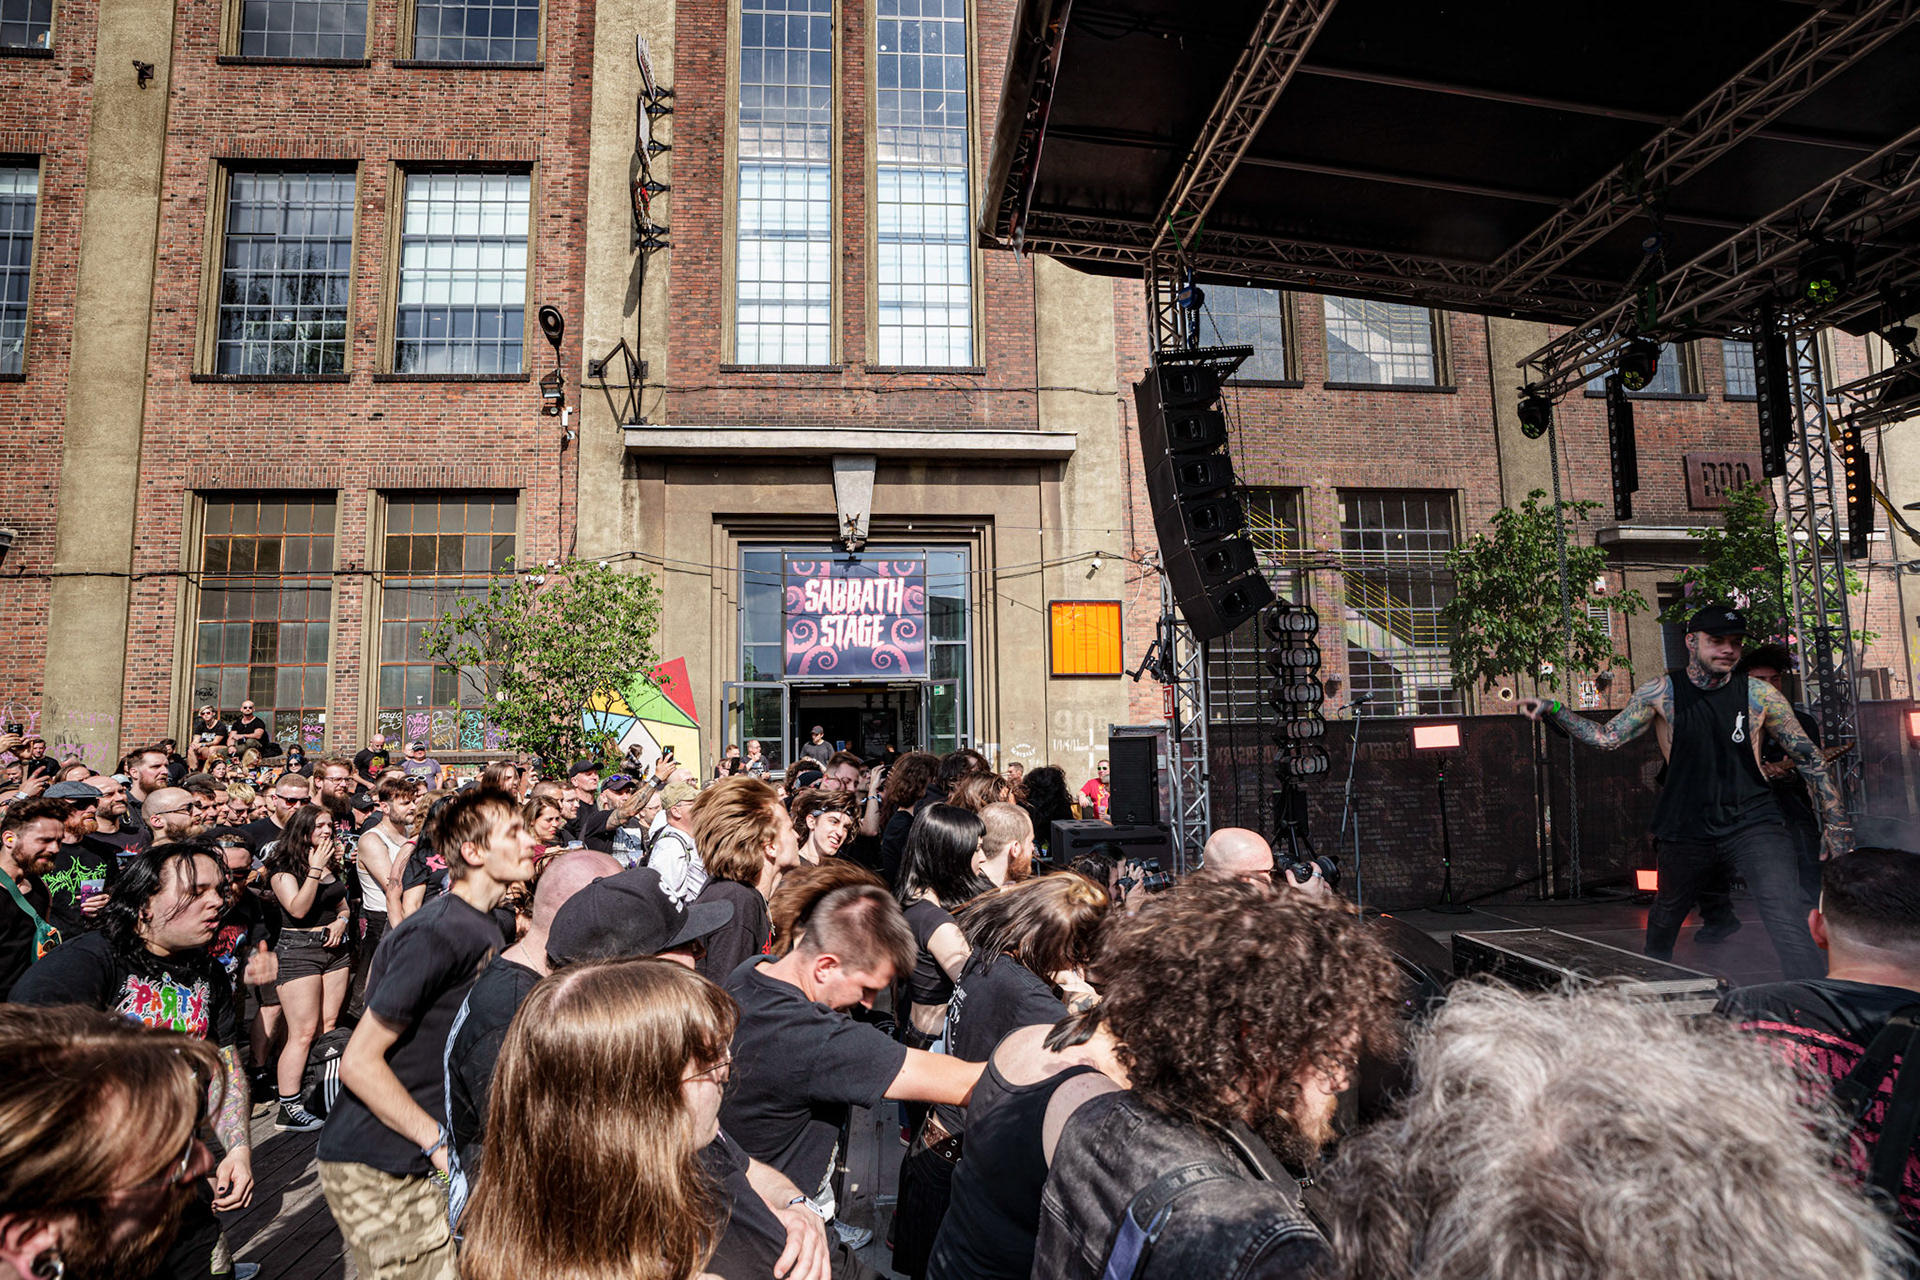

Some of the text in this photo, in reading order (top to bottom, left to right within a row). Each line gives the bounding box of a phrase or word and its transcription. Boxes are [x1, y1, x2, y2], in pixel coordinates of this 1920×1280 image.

[804, 577, 905, 618] SABBATH
[820, 614, 886, 651] STAGE
[122, 977, 209, 1021] PARTY
